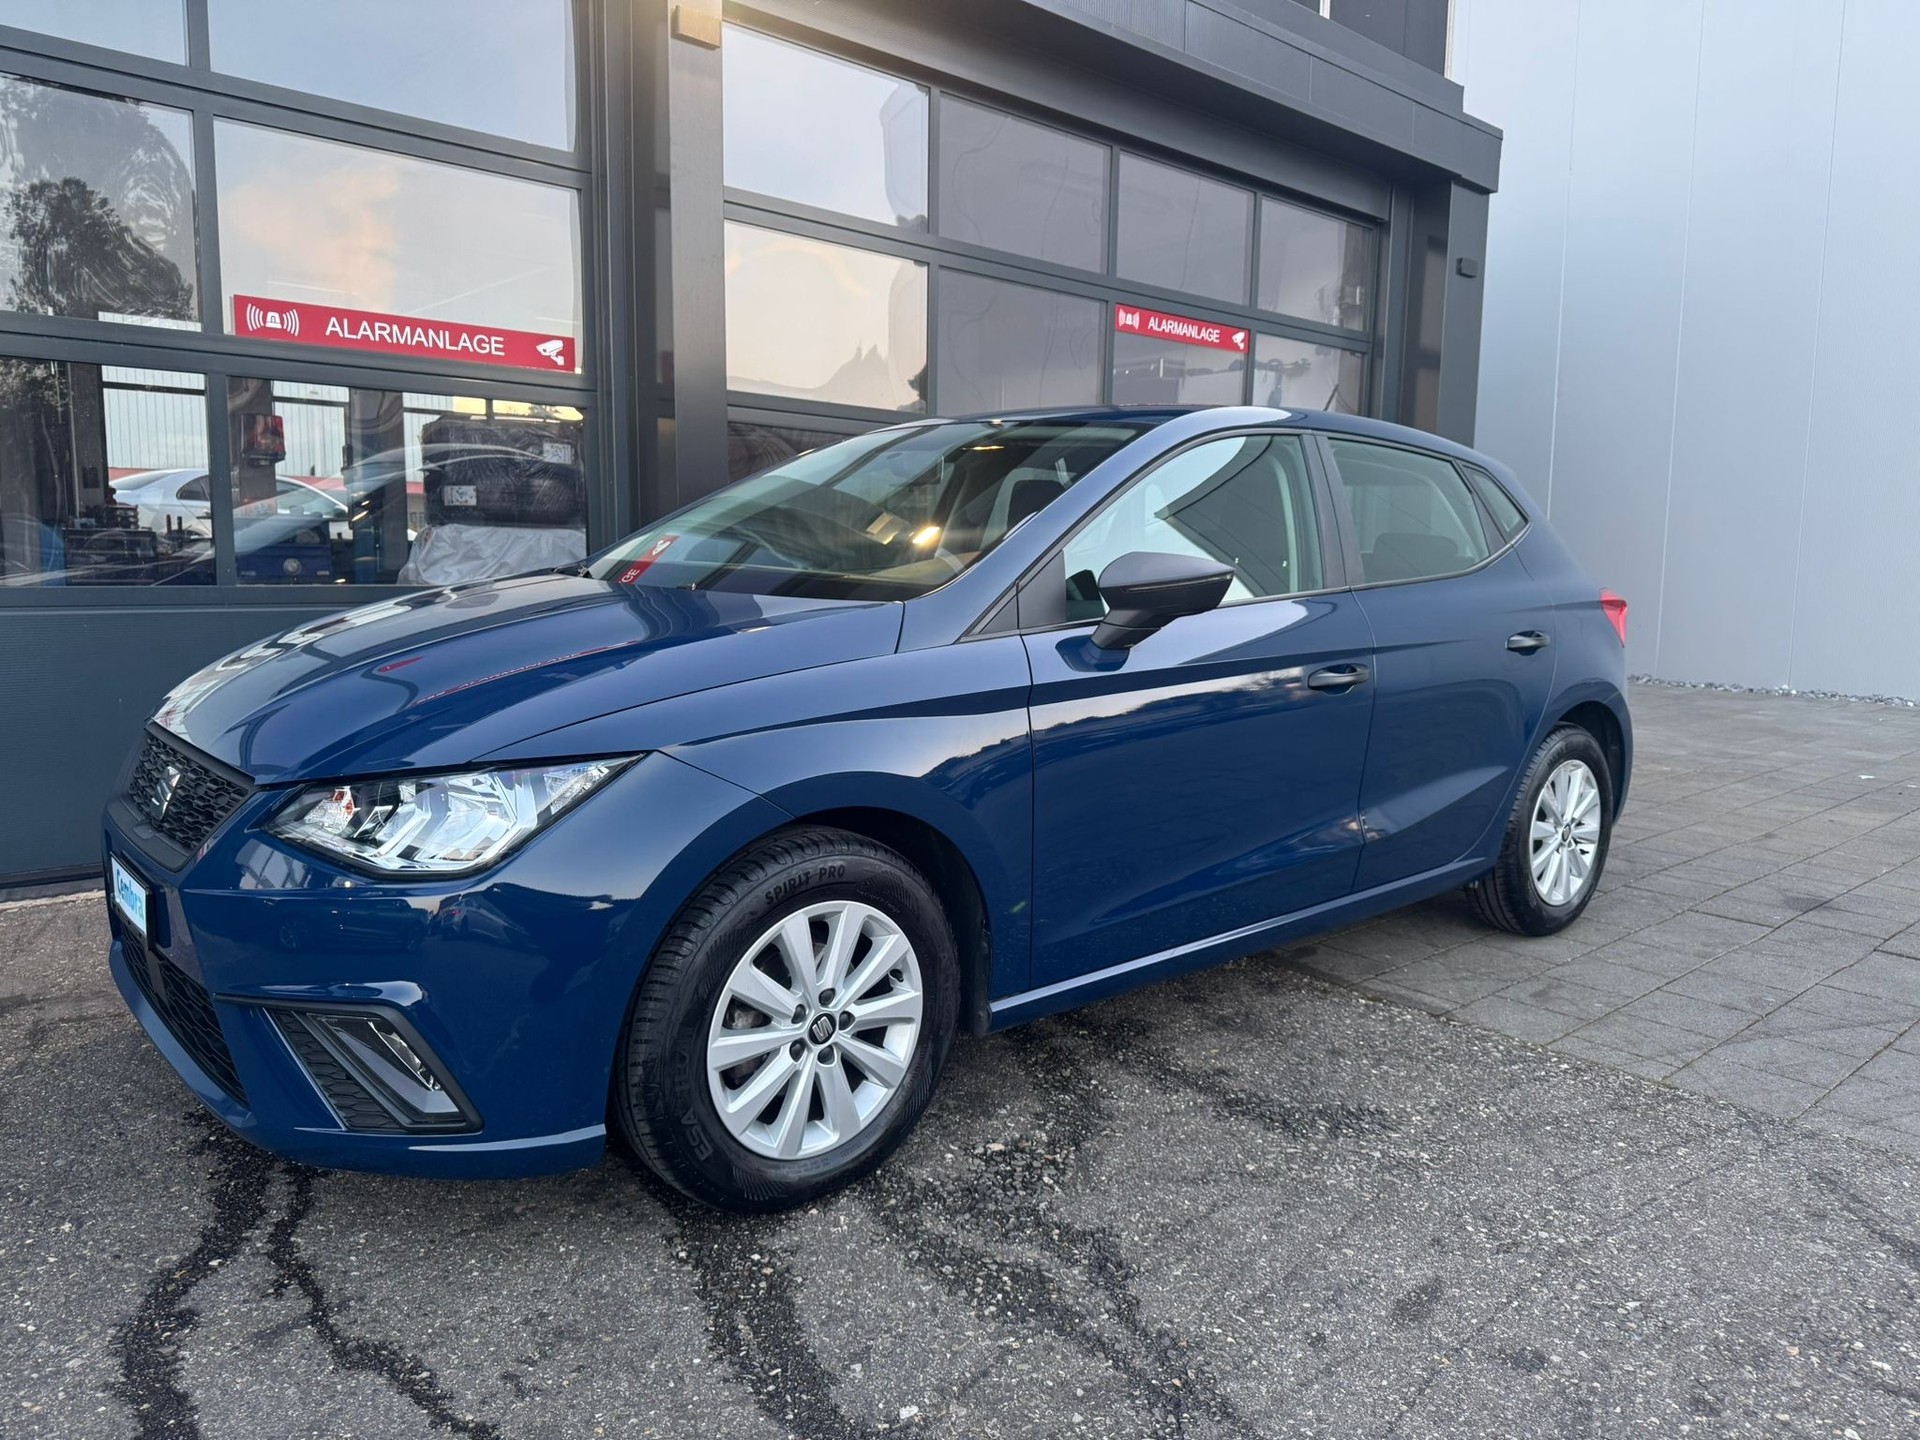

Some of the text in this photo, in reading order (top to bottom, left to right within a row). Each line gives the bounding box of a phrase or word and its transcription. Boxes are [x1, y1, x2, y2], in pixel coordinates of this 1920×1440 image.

[325, 316, 505, 356] ALARMANLAGE
[1148, 316, 1220, 343] ALARMANLAGE
[764, 865, 845, 905] SPIRIT PRO
